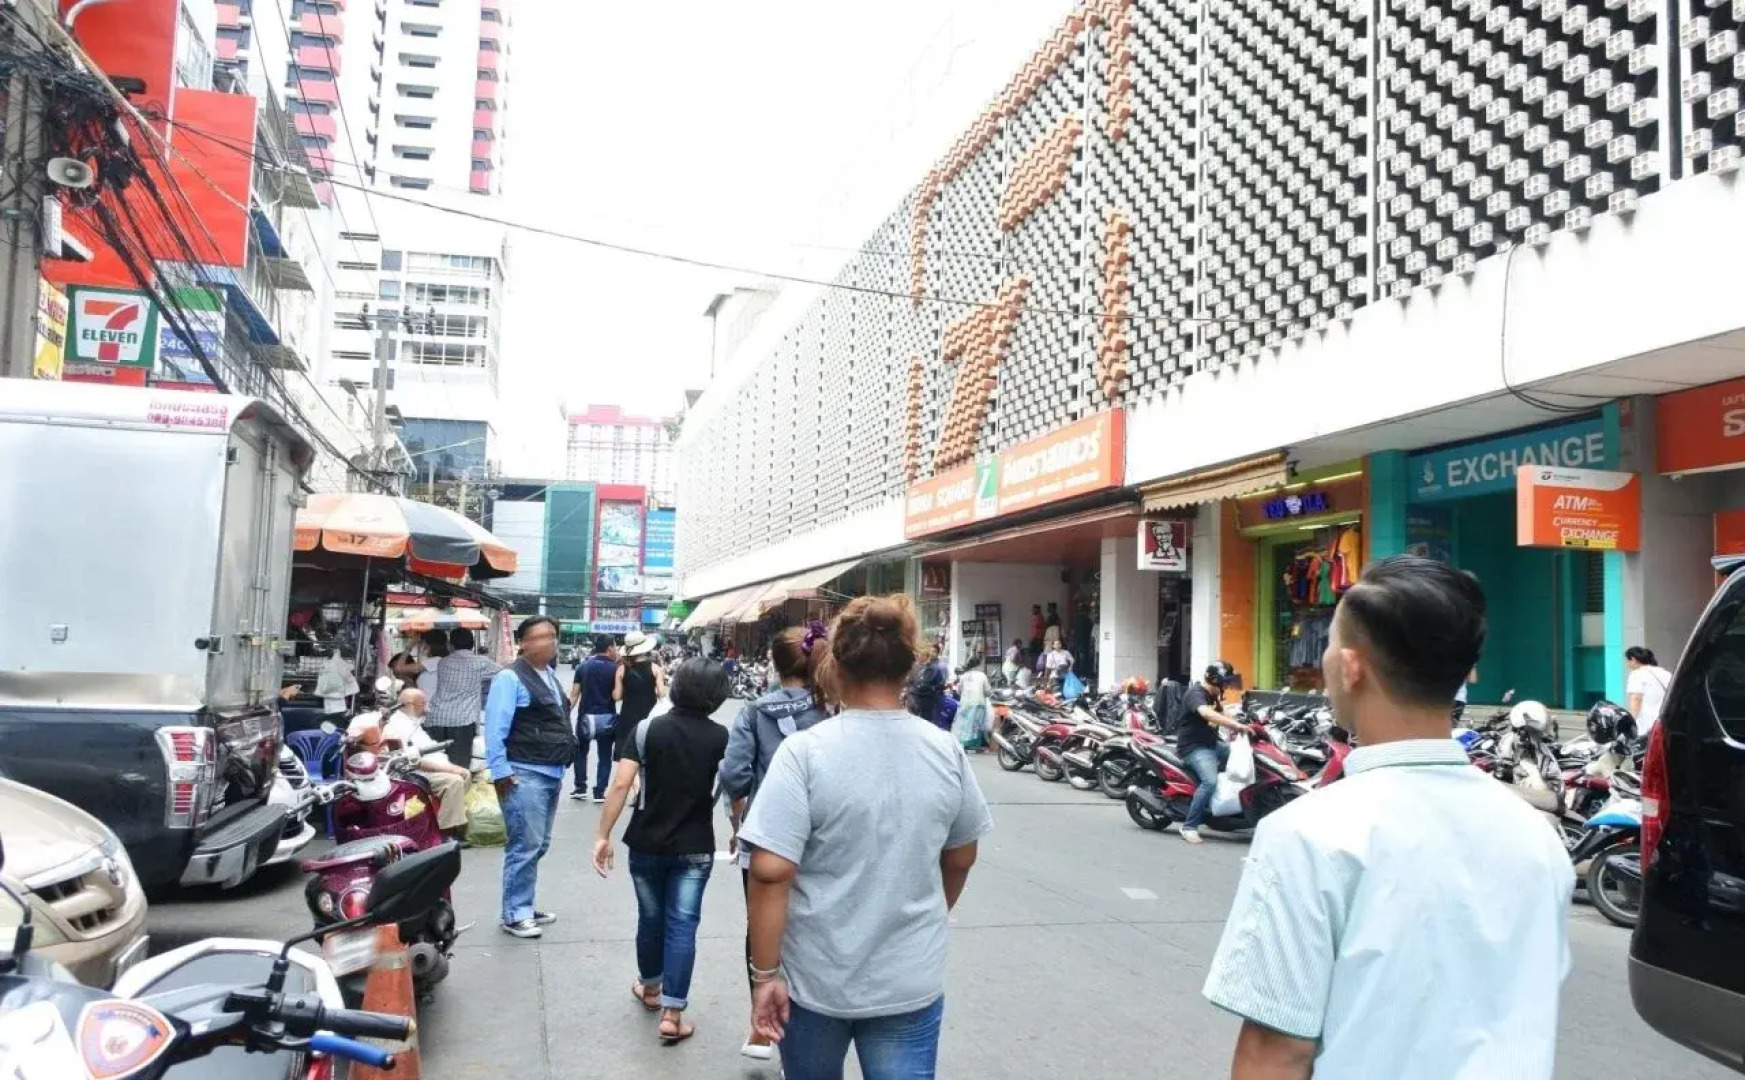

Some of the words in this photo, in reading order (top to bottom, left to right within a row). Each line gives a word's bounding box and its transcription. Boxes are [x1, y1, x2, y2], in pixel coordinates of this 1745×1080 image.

[1447, 432, 1604, 488] EXCHANGE
[1553, 494, 1588, 511] ATM
[1553, 516, 1598, 527] CURRENCY
[1560, 527, 1619, 541] EXCHANGE
